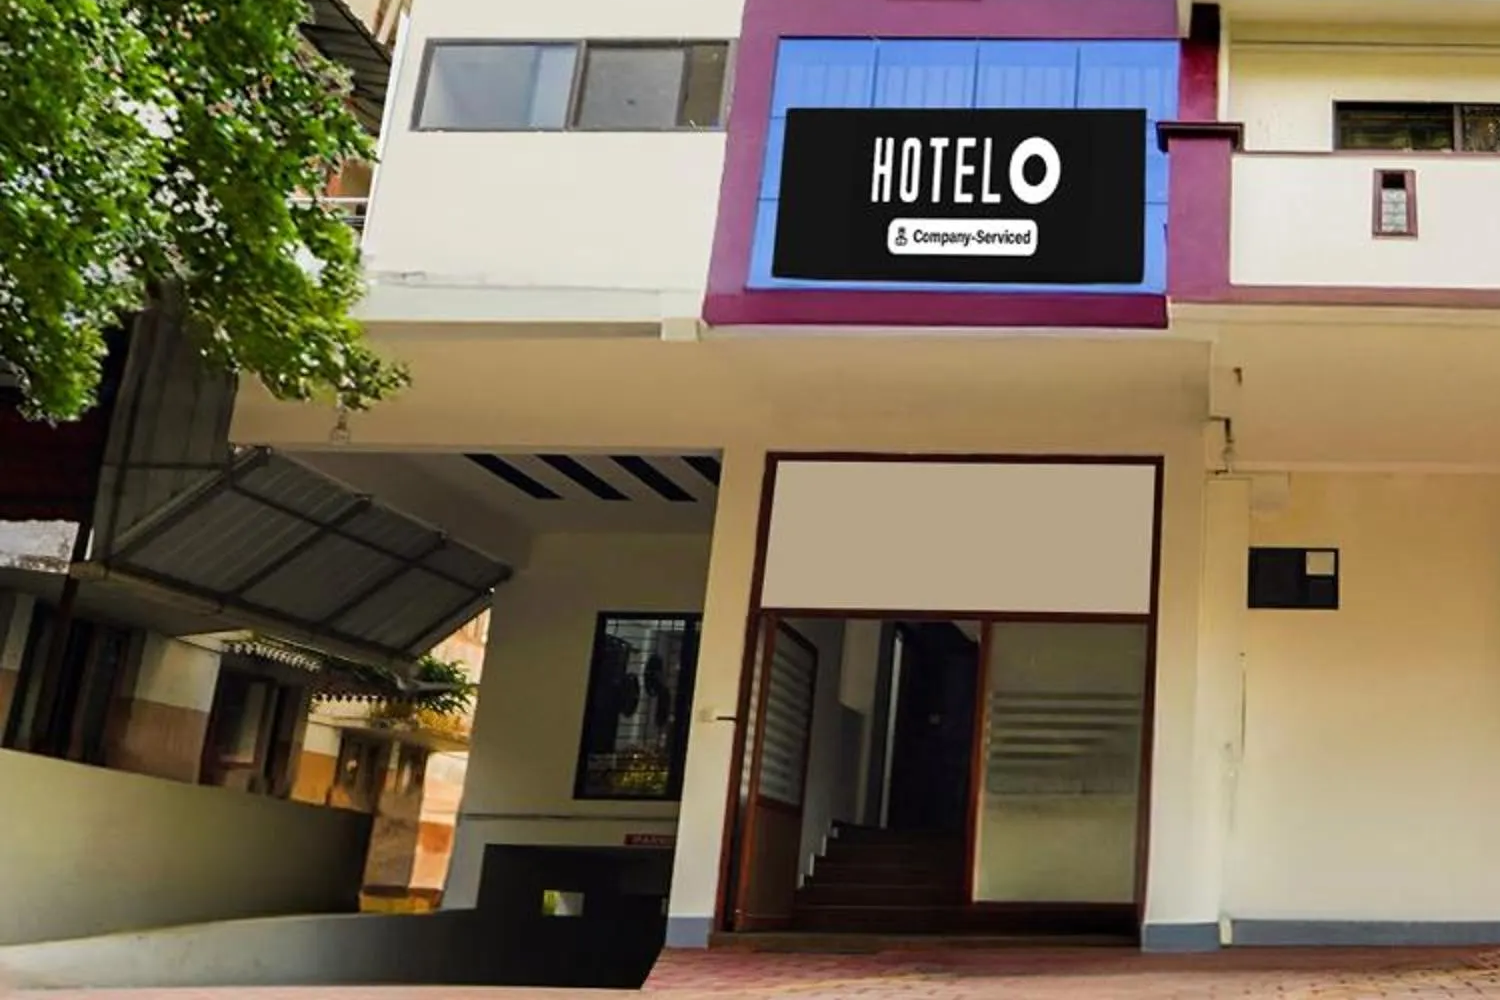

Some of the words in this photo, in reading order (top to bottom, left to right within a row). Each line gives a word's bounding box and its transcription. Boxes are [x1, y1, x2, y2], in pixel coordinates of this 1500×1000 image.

[871, 137, 1001, 204] HOTEL
[1009, 136, 1061, 205] O
[912, 228, 1032, 248] Company-Serviced
